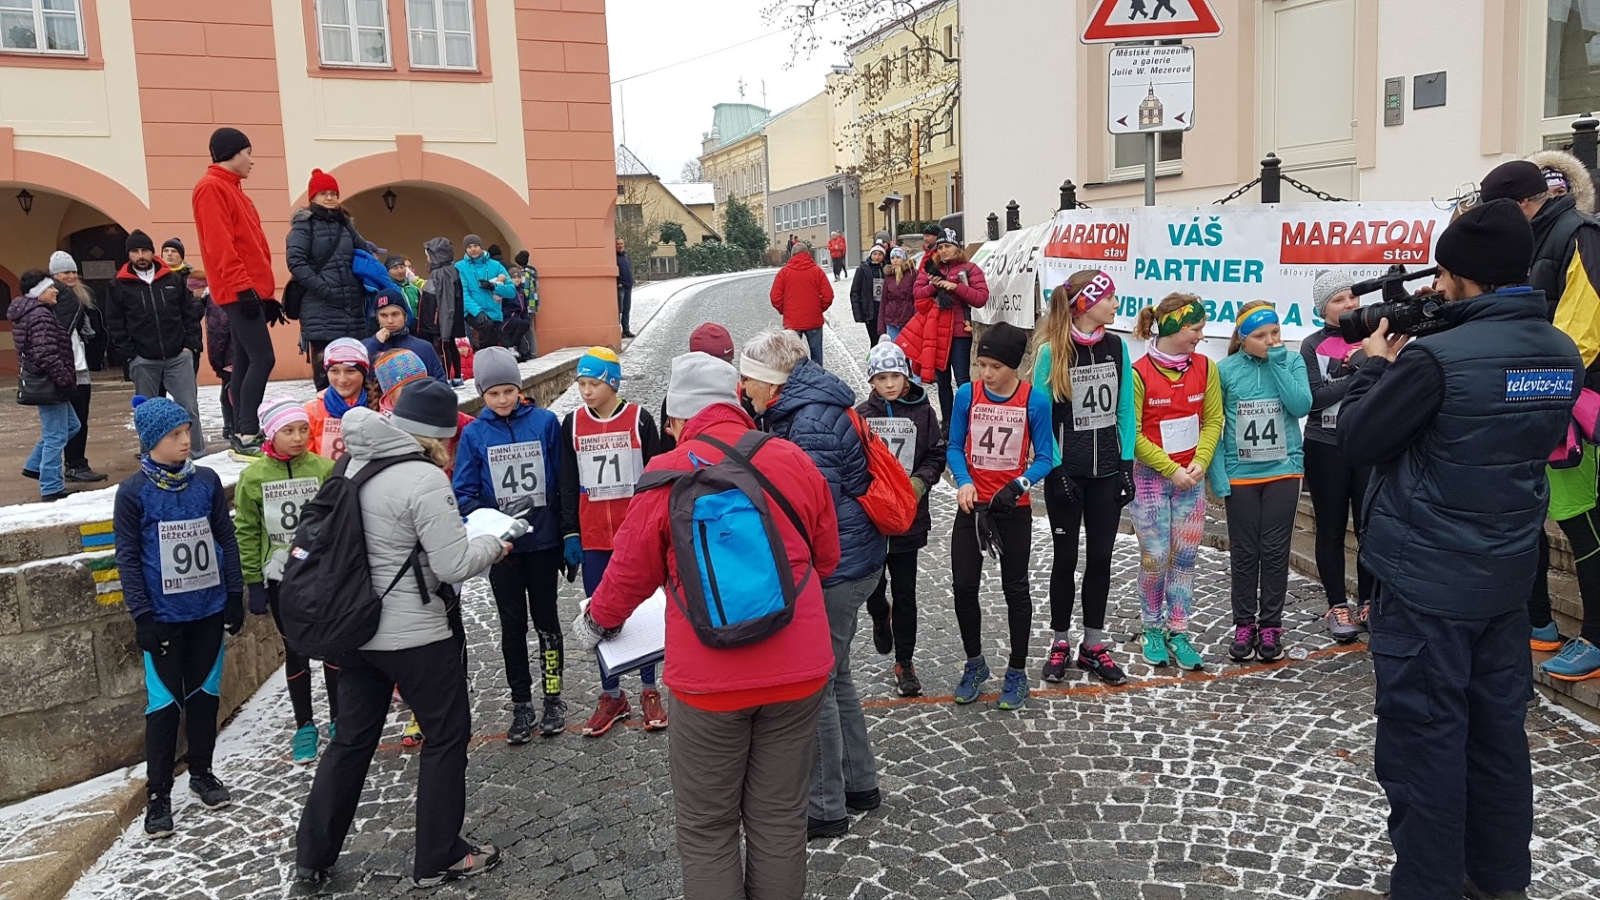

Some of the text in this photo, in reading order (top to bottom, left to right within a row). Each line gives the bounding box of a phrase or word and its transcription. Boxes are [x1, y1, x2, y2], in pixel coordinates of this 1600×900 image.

[1115, 48, 1189, 57] Městské muzeum
[1141, 57, 1171, 67] galerie
[1136, 67, 1147, 75] W.
[1150, 65, 1192, 74] Mezerové
[1050, 223, 1130, 244] MARATON
[1167, 216, 1223, 246] VÁŠ
[1281, 220, 1436, 246] MARATON
[1103, 247, 1126, 257] stav
[1383, 248, 1424, 260] stav
[1078, 264, 1127, 272] společnost
[1134, 258, 1264, 283] PARTNER
[1348, 268, 1392, 277] jednot
[1282, 303, 1303, 326] A
[1072, 367, 1092, 376] ZIMNÍ
[1072, 374, 1101, 383] BĚŽECKÁ
[1102, 371, 1116, 380] LIGA
[1082, 383, 1112, 414] 40
[975, 406, 996, 414] ZIMNÍ
[974, 414, 1004, 422] BĚŽECKÁ
[324, 426, 341, 434] BĚŽE
[1163, 421, 1191, 439] 37
[1243, 418, 1278, 446] 44
[580, 436, 600, 445] ZIMNÍ
[580, 441, 630, 452] BĚŽECKÁ LIGA
[979, 426, 1014, 456] 47
[490, 446, 511, 455] ZIMNÍ
[490, 453, 523, 463] BĚŽECKÁ
[525, 450, 541, 458] LIGA
[592, 453, 622, 485] 71
[502, 462, 538, 494] 45
[264, 489, 299, 499] BĚŽECKÁ
[301, 487, 319, 495] LIGA
[265, 482, 287, 492] ZIMNÍ
[161, 523, 187, 532] ZIMNÍ
[161, 527, 211, 540] BĚŽECKÁ LIGA
[172, 540, 210, 575] 90
